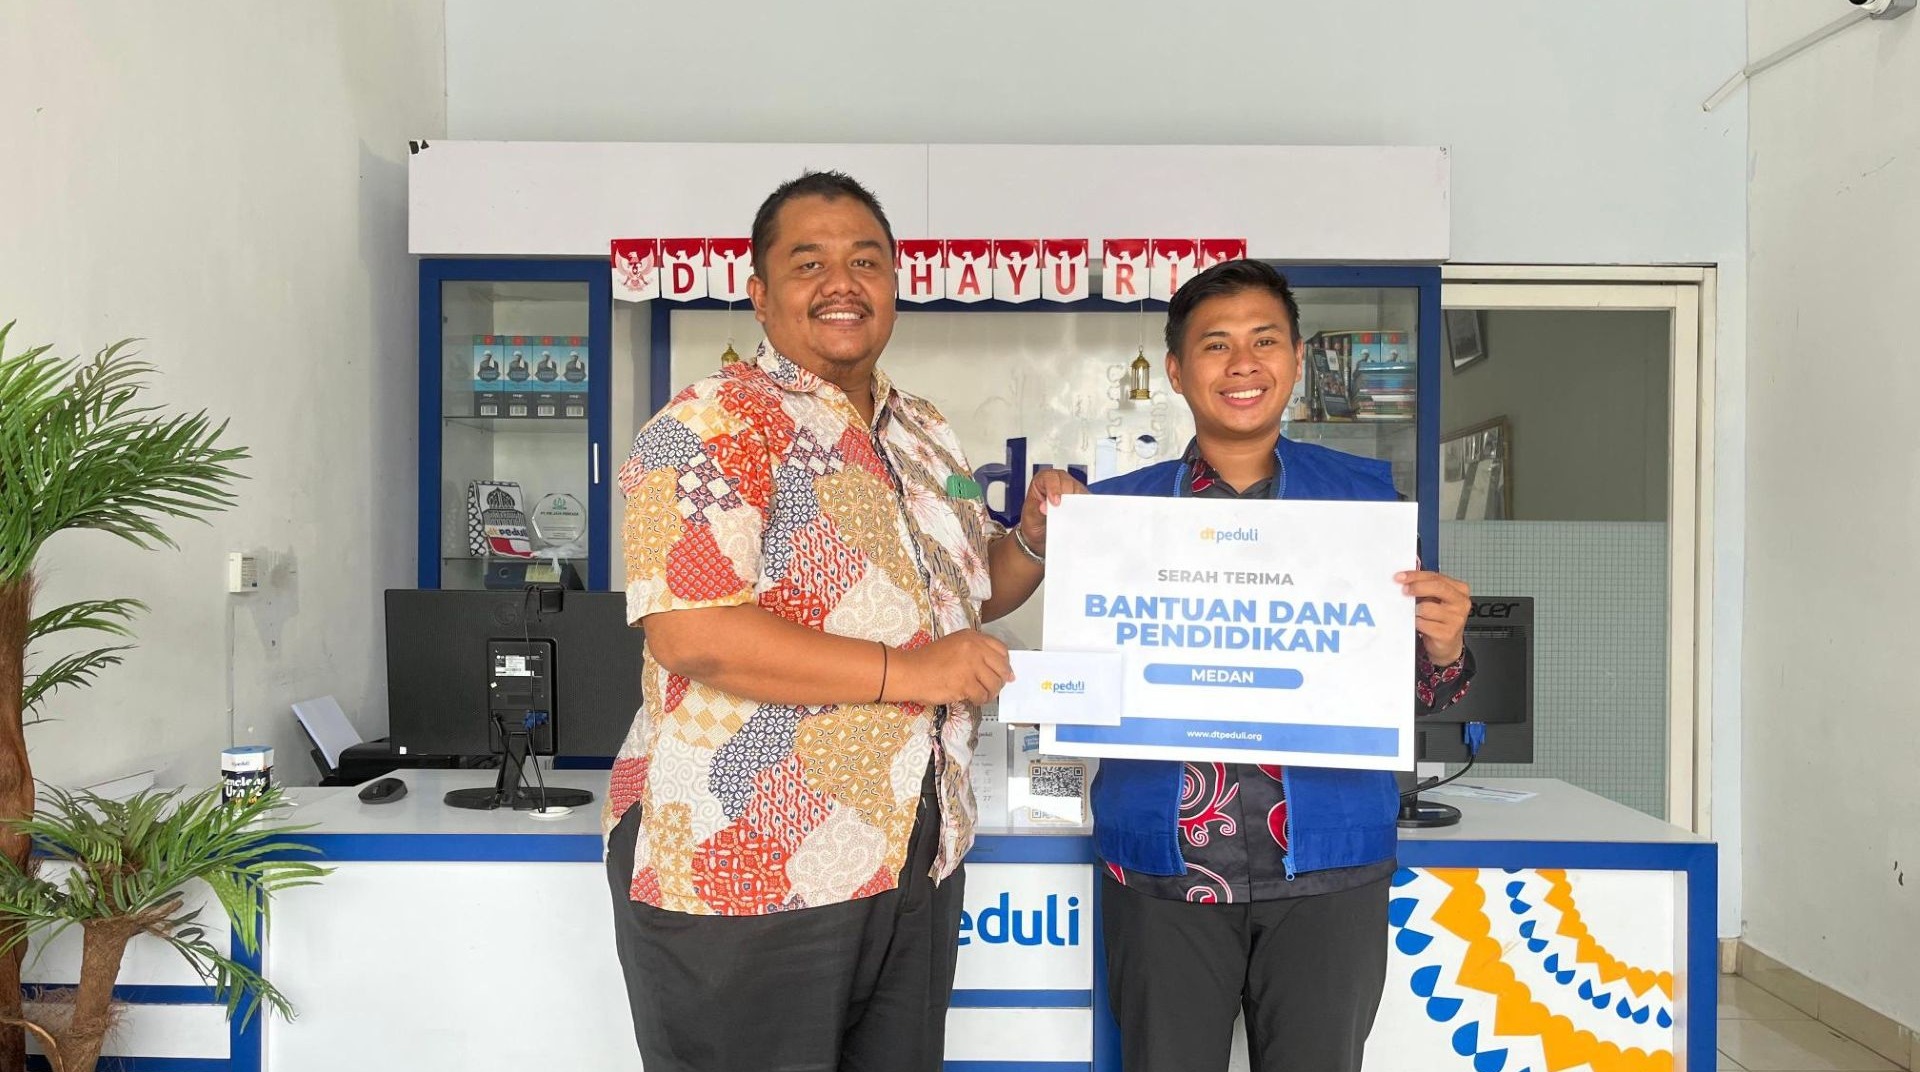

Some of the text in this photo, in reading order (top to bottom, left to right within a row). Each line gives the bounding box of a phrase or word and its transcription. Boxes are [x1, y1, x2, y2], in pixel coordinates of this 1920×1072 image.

[1115, 263, 1178, 296] RI
[1200, 527, 1258, 543] dtpeduli
[1158, 569, 1294, 586] SERAH TERIMA
[1085, 594, 1376, 627] BANTUAN DANA
[1116, 622, 1340, 653] PENDIDIKAN
[1191, 668, 1254, 684] MEDAN
[1186, 730, 1263, 742] www.dtpeduli.org
